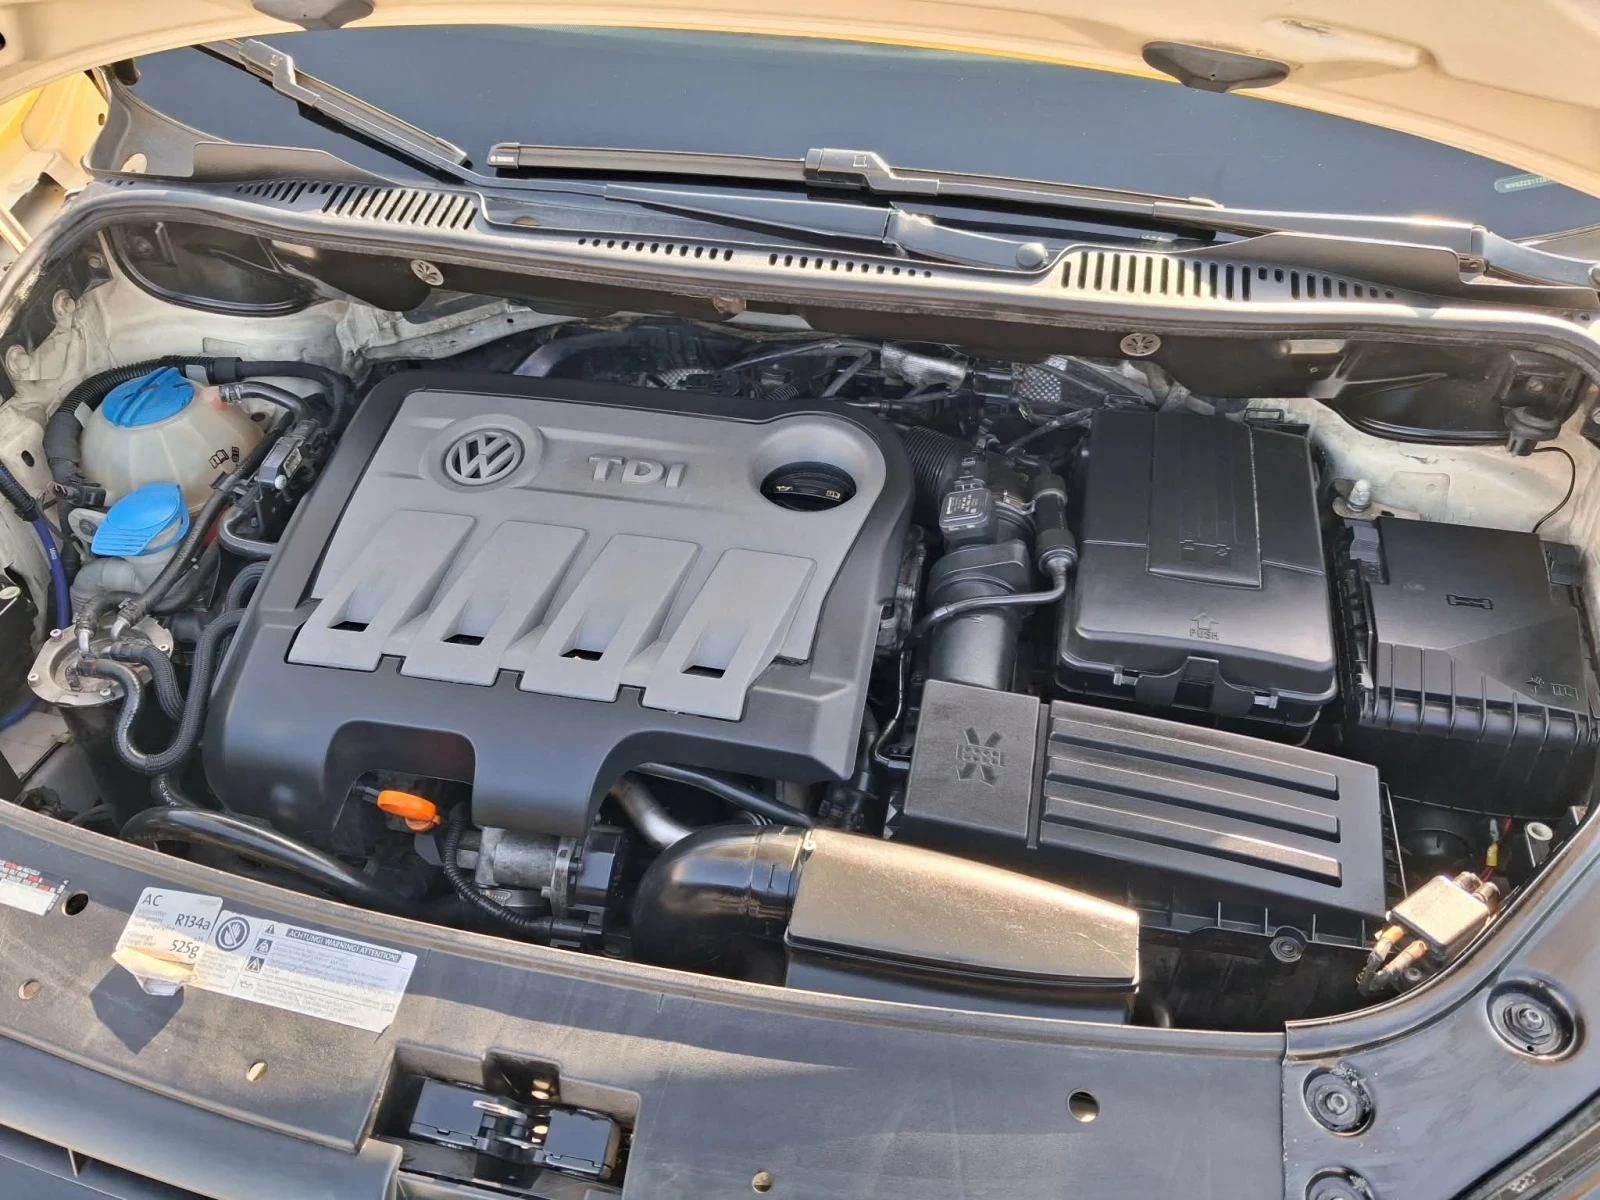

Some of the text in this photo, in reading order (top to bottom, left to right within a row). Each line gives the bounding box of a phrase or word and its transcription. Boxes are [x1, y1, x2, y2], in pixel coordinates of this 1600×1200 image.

[446, 429, 522, 484] VW
[588, 456, 687, 488] TDI
[1189, 628, 1219, 640] PUSH
[141, 893, 163, 906] AC
[174, 913, 211, 930] R134a
[169, 939, 201, 959] 525g
[288, 930, 400, 961] ACHTUNG! WARNING! ATTENTION!
